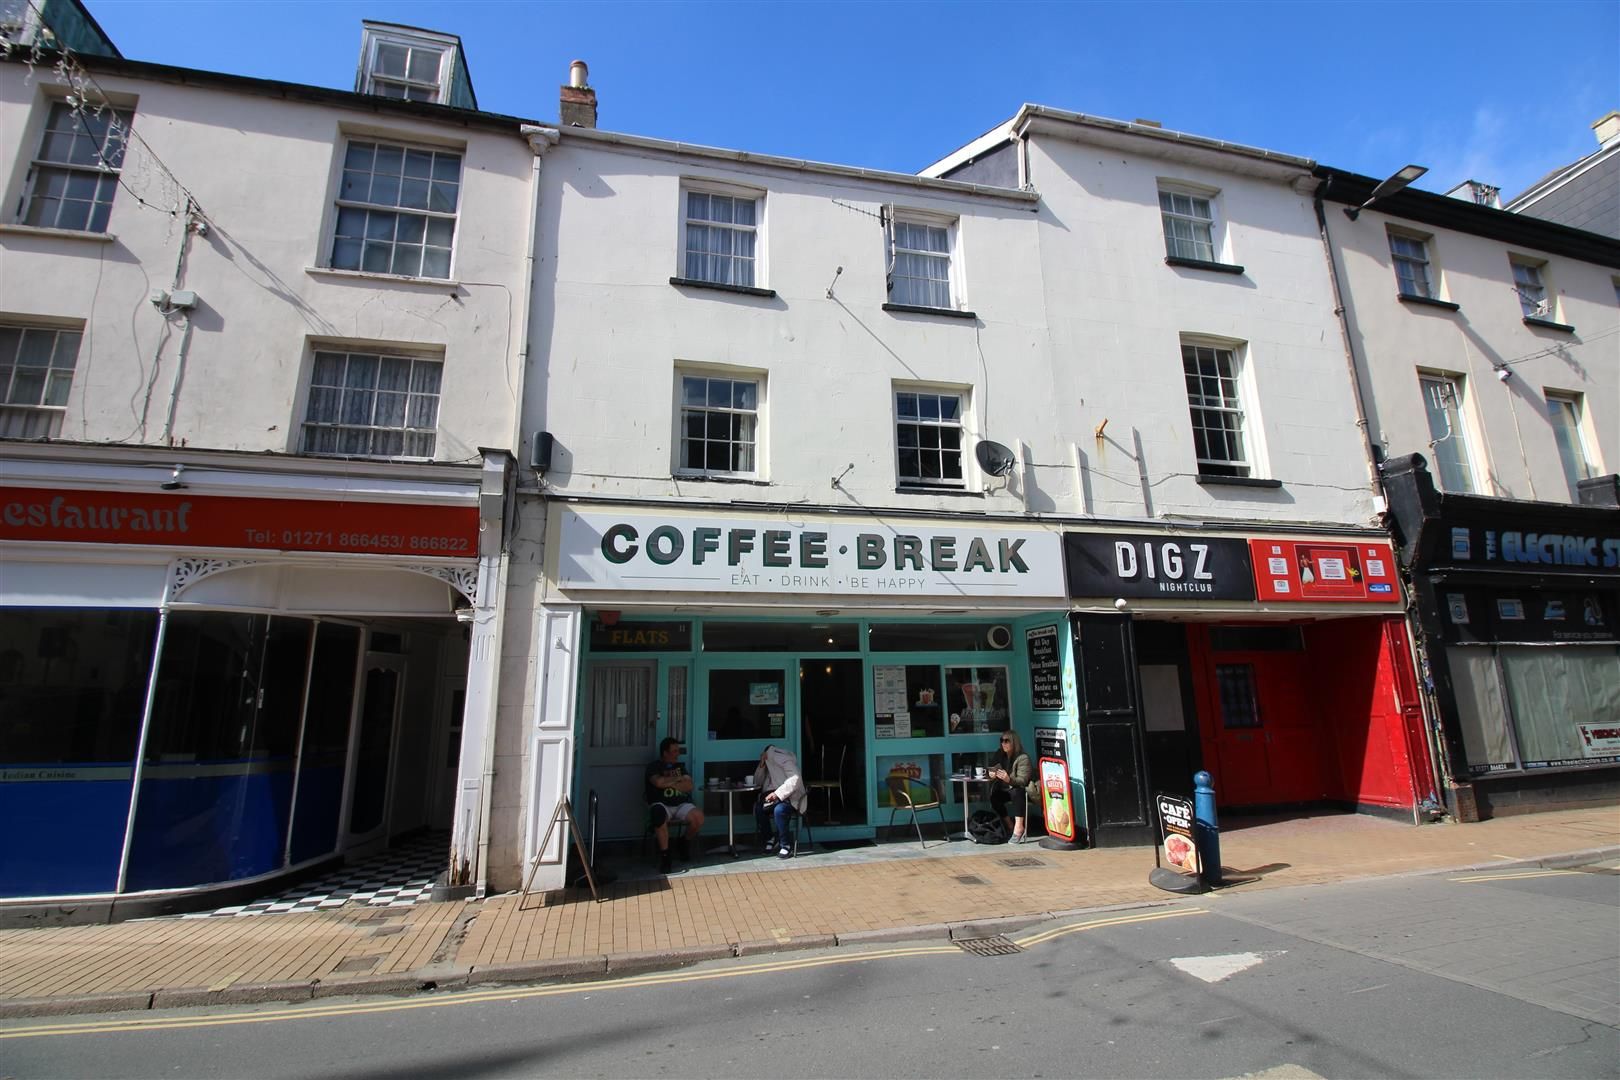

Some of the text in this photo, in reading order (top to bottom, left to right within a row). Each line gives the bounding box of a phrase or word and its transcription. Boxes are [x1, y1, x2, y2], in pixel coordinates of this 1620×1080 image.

[0, 496, 192, 533] estaurant
[244, 528, 276, 544] Tel:
[282, 530, 333, 545] 01271
[410, 536, 469, 550] 866822
[600, 523, 1030, 574] COFFEE BREAK
[1501, 531, 1598, 566] ELECTRIC
[1115, 541, 1213, 580] DIGZ
[731, 574, 926, 589] EAT DRINK BE HAPPY
[1159, 582, 1213, 592] NIGHTCLUB
[611, 630, 669, 644] FLATS
[38, 770, 77, 779] Cuisine
[1160, 802, 1191, 820] CAFÉ
